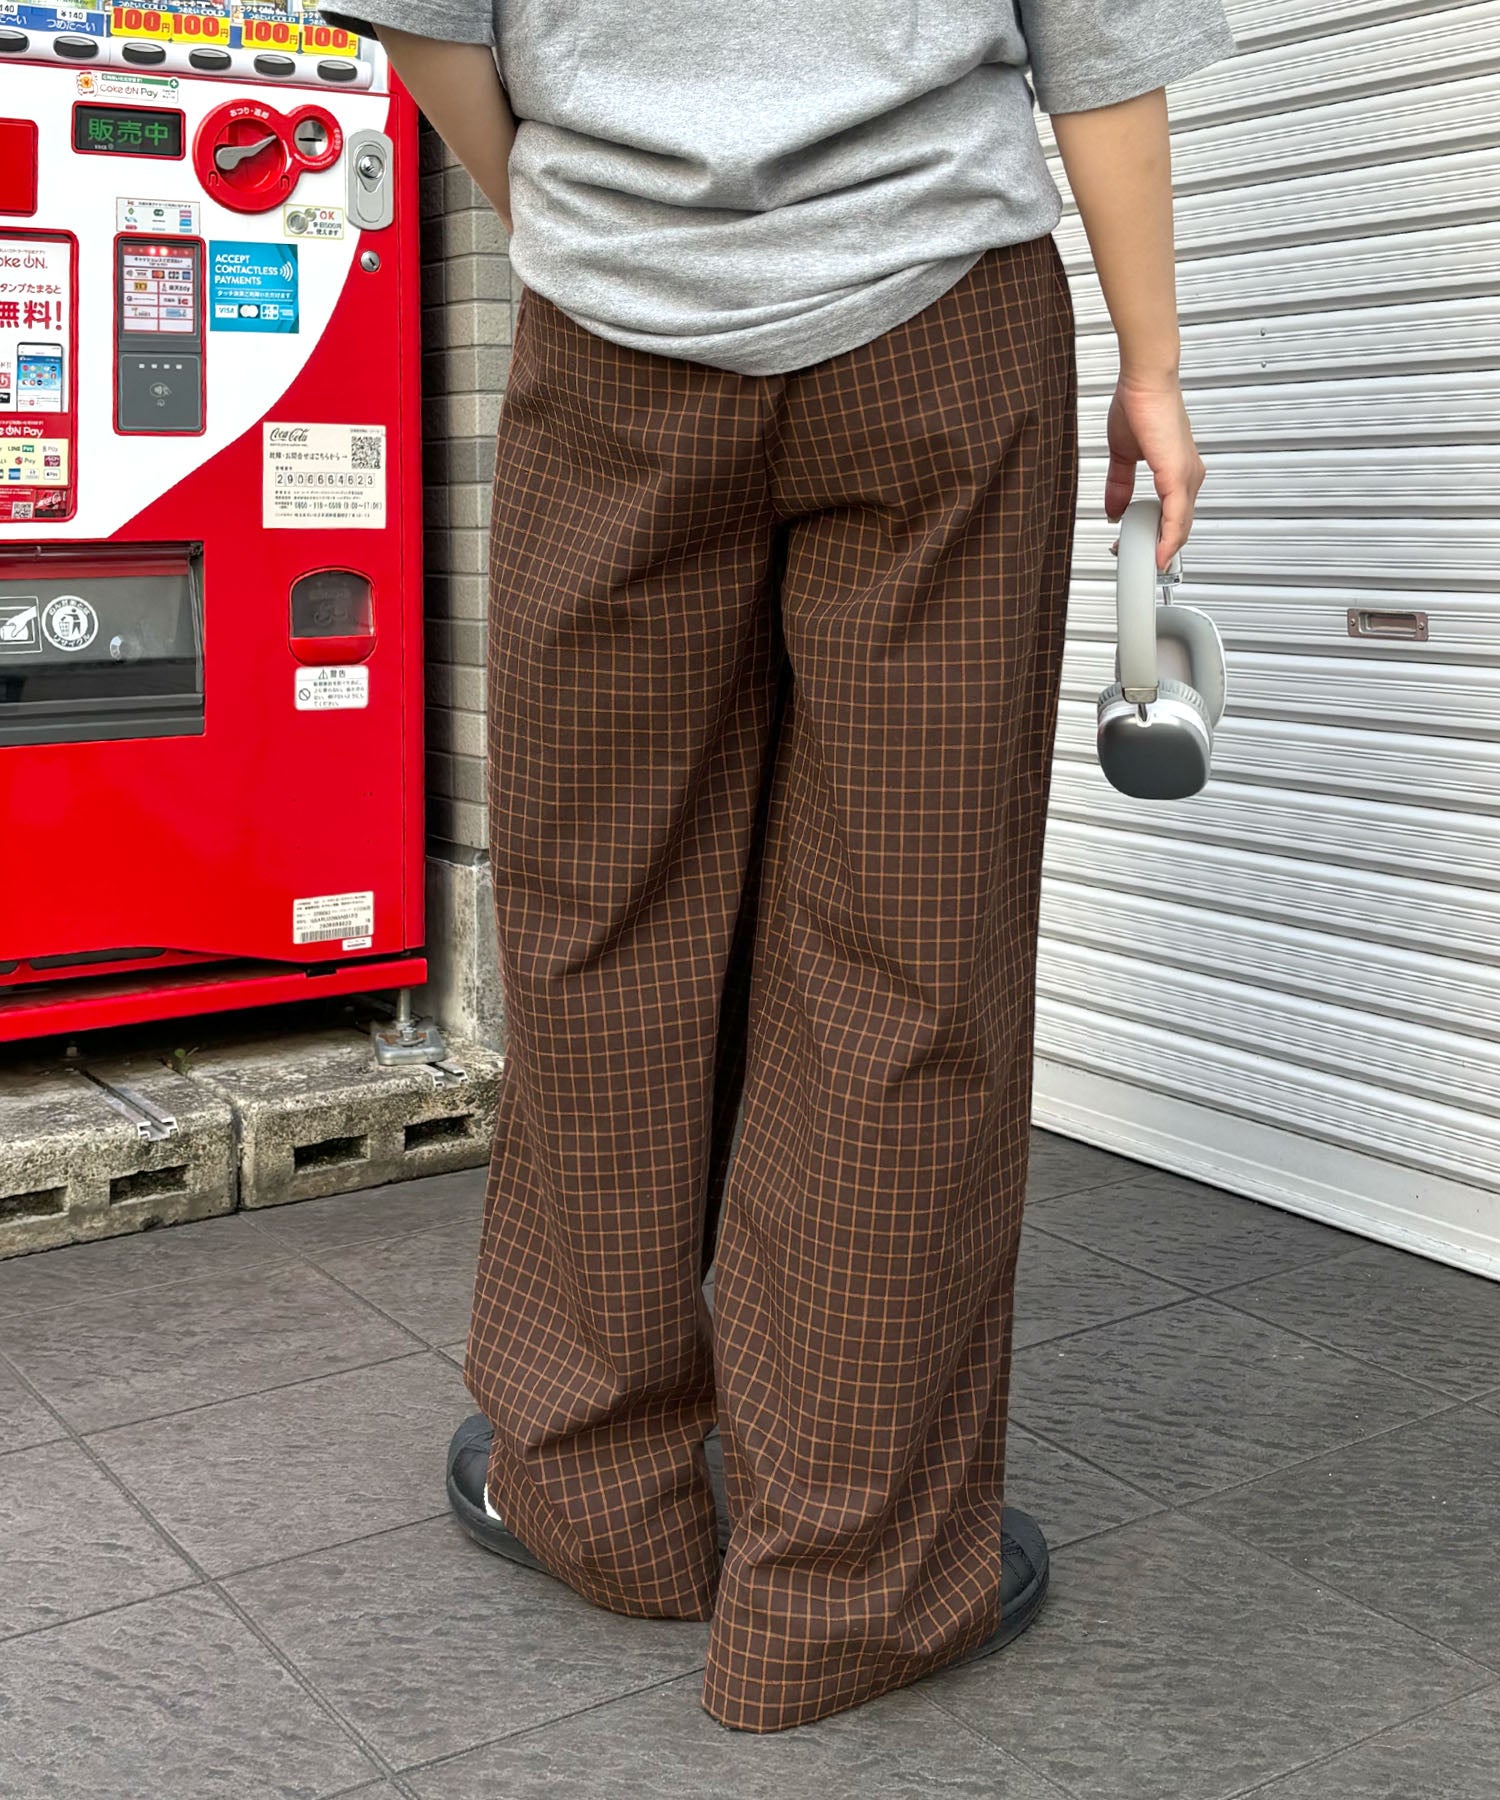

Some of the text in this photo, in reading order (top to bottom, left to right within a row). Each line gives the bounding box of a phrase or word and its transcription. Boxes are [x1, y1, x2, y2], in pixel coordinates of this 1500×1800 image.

[100, 84, 124, 94] Coke
[141, 87, 159, 99] Pay
[88, 118, 169, 147] 販売中
[319, 210, 336, 220] OK
[215, 254, 250, 264] ACCEPT
[215, 265, 278, 276] CONTACTLESS
[215, 276, 262, 285] PAYMENTS
[23, 427, 43, 438] Pay
